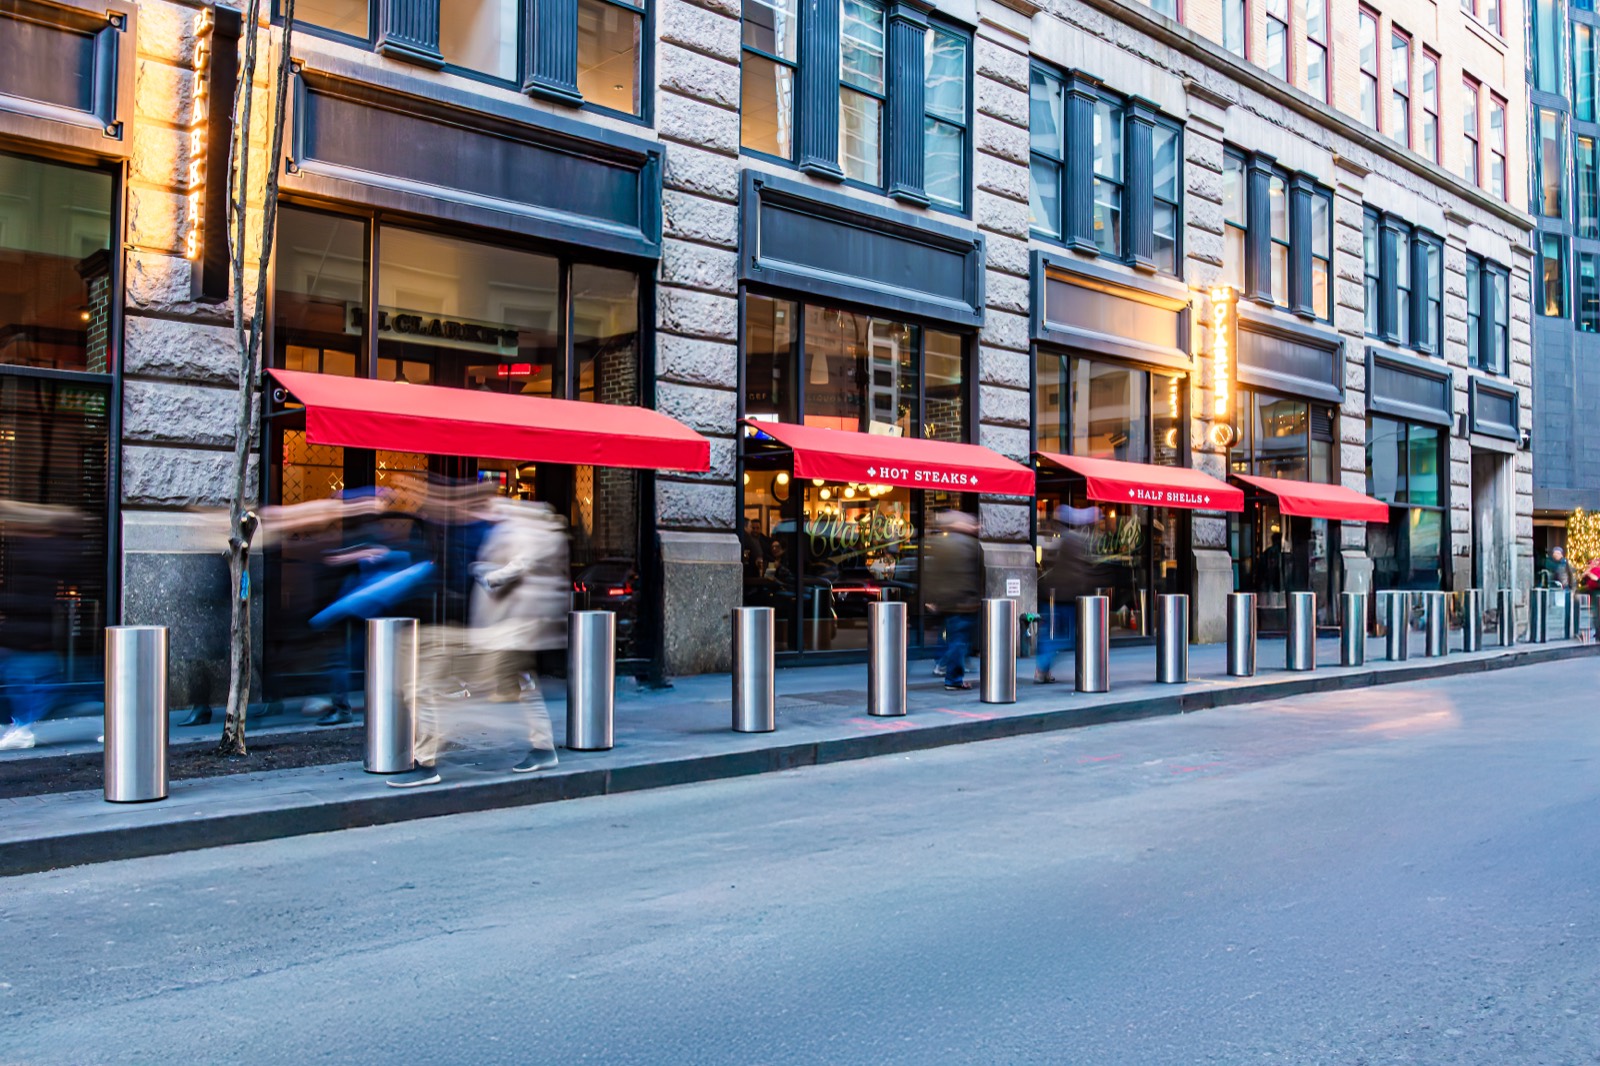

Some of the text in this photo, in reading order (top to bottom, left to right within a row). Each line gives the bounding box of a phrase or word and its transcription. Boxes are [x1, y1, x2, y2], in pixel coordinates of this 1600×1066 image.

[879, 467, 968, 485] HOT STEAKS
[1137, 489, 1203, 504] HALF SHELLS
